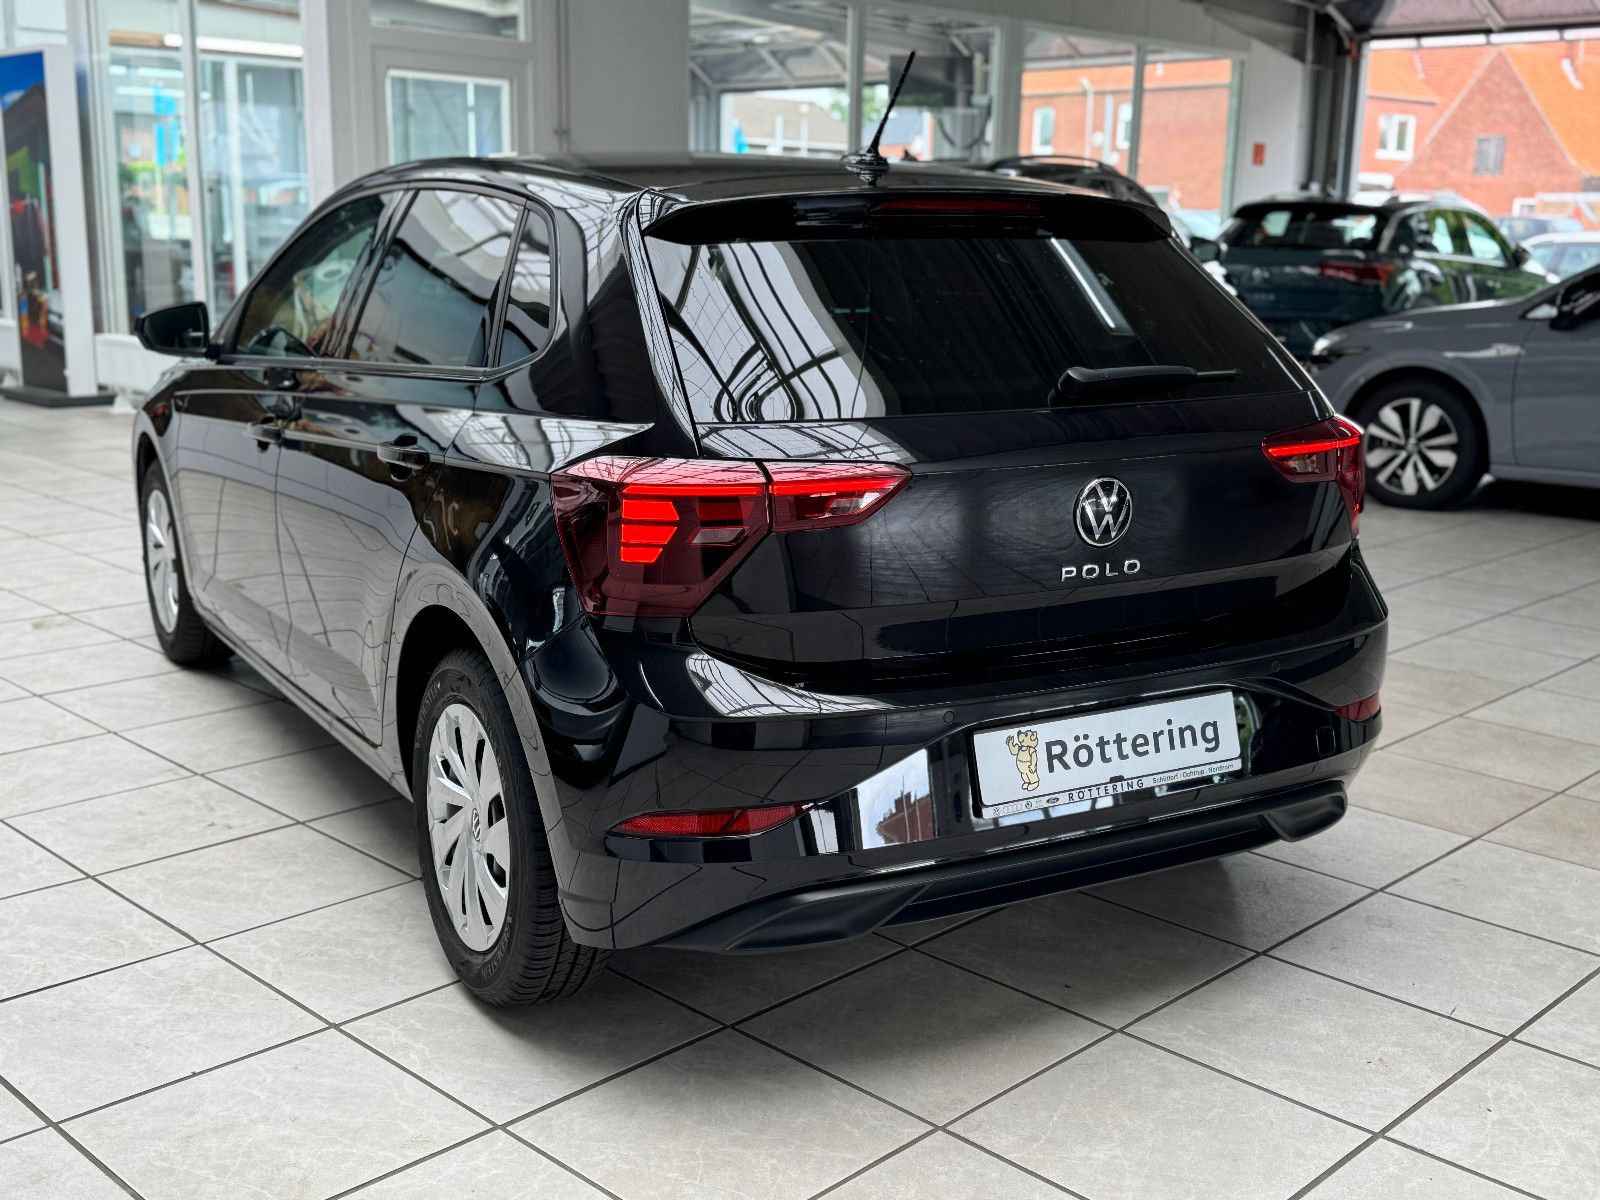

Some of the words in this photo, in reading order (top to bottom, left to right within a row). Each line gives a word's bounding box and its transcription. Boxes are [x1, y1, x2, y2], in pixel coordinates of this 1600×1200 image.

[1061, 559, 1141, 582] POLO
[1045, 718, 1220, 774] Röttering
[1068, 778, 1144, 802] RÖTTERING
